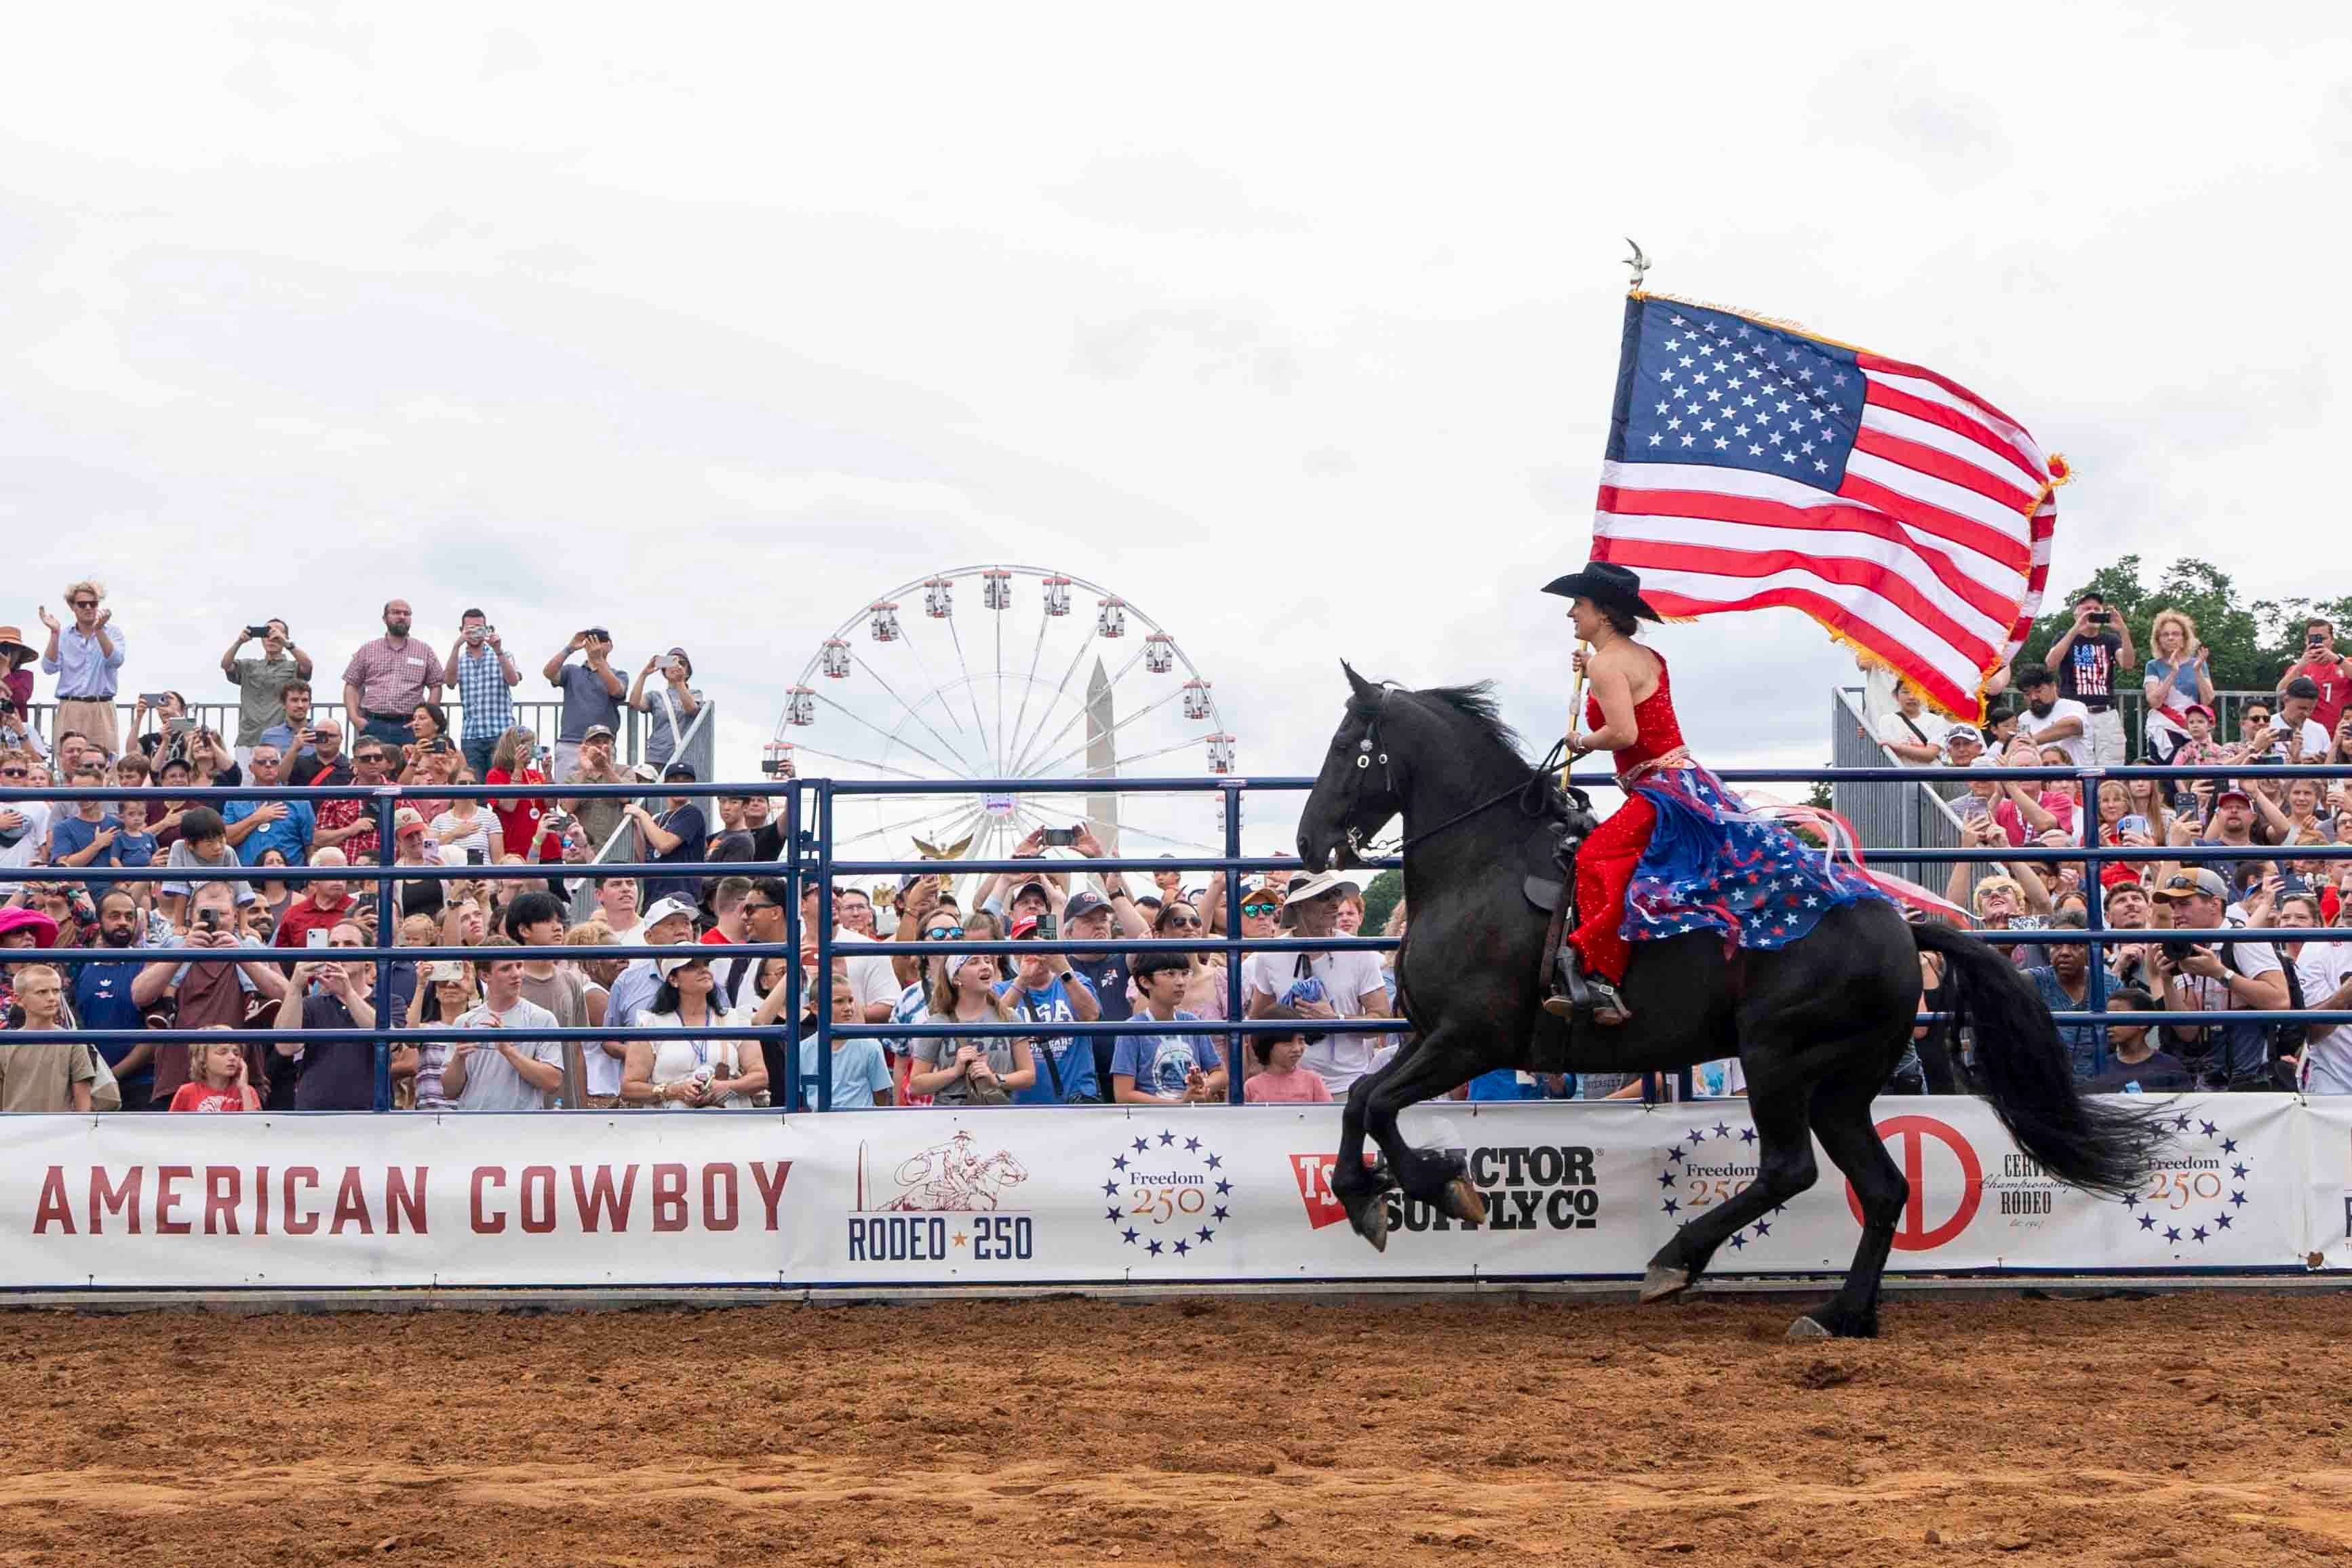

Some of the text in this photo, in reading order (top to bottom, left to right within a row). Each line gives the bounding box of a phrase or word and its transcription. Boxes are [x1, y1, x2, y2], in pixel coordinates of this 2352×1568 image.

[1129, 1171, 1204, 1185] Freedom
[1293, 1156, 1339, 1205] TS
[1445, 1145, 1596, 1187] CTOR
[1687, 1162, 1759, 1177] Freedom
[2148, 1155, 2220, 1171] Freedom
[33, 1160, 793, 1235] AMERICAN COWBOY
[1131, 1187, 1205, 1224] 250
[2001, 1191, 2052, 1215] RODEO
[2147, 1172, 2222, 1211] 250
[848, 1217, 1032, 1261] RODEO 250
